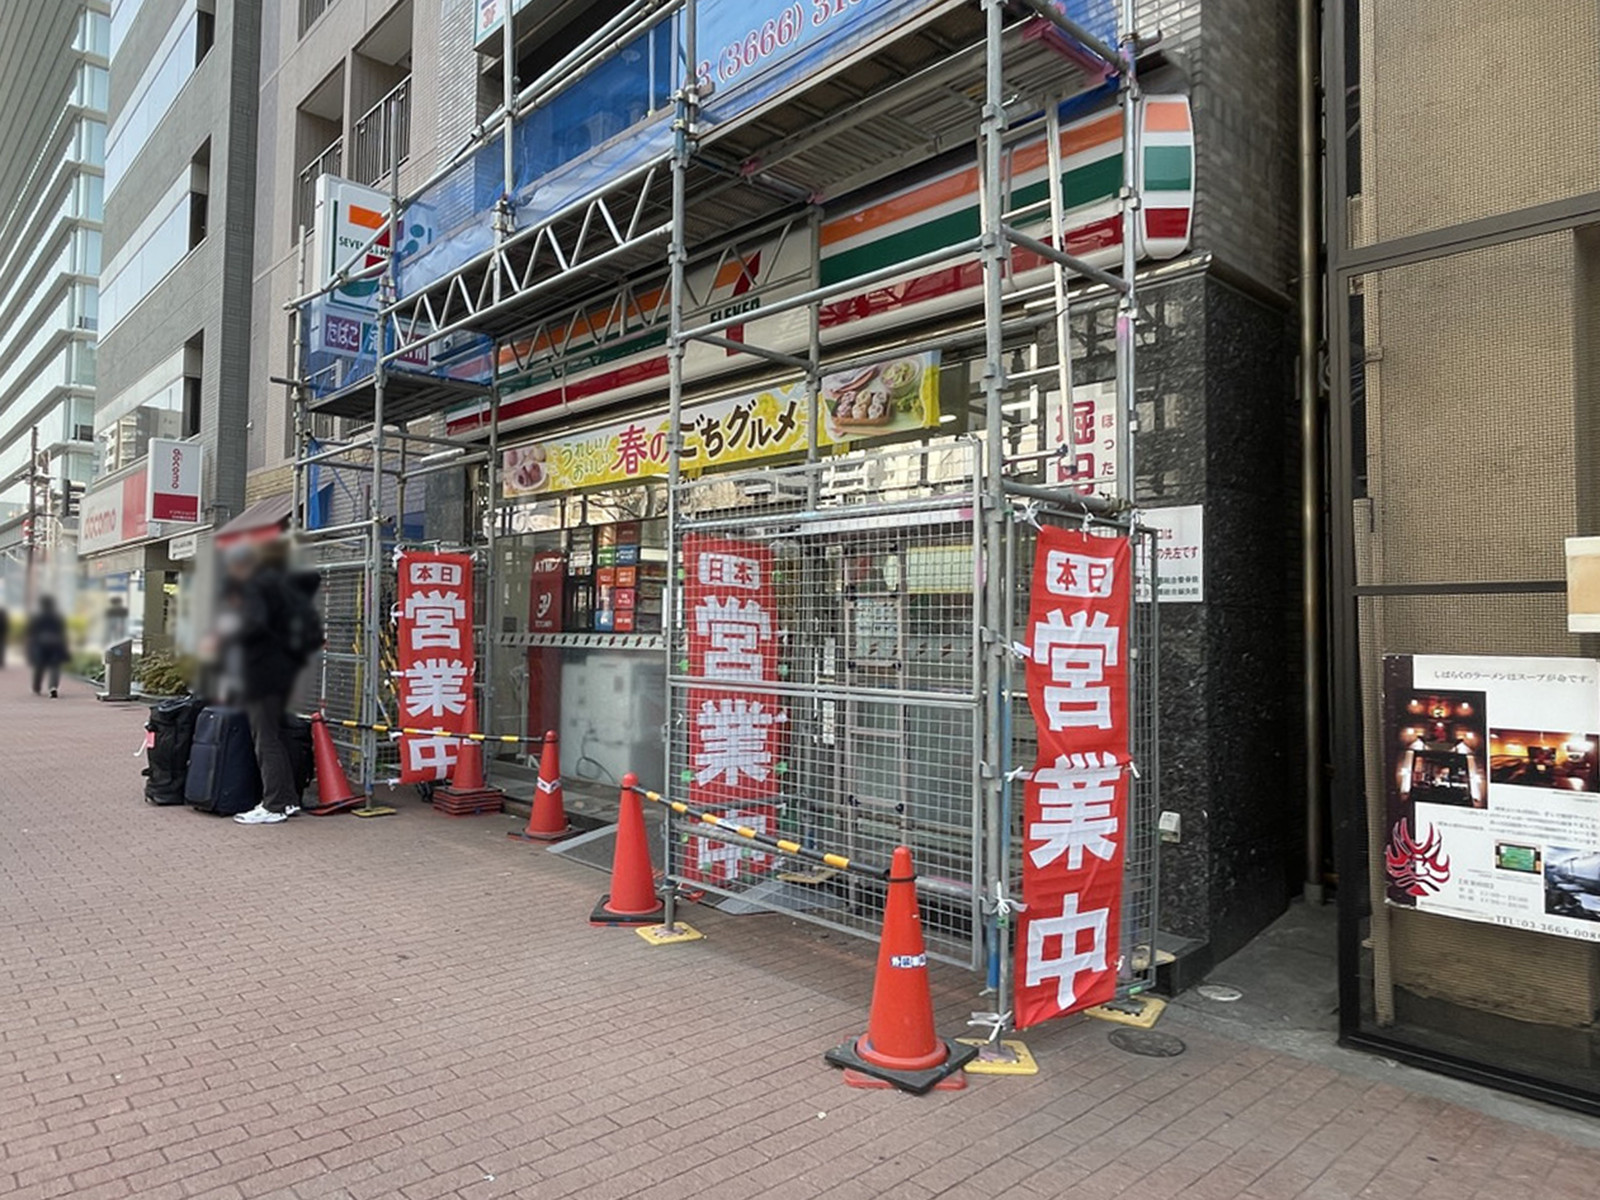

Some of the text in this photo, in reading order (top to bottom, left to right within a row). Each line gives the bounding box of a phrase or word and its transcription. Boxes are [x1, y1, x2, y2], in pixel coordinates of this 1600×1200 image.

[717, 4, 804, 84] (3666)
[327, 319, 359, 347] たばこ
[611, 400, 797, 475] 春のごちグルメ
[171, 448, 182, 489] docomo
[416, 564, 453, 582] 本日
[1056, 558, 1107, 593] 本日
[405, 589, 468, 780] 営業中
[1025, 608, 1120, 1010] 営業中
